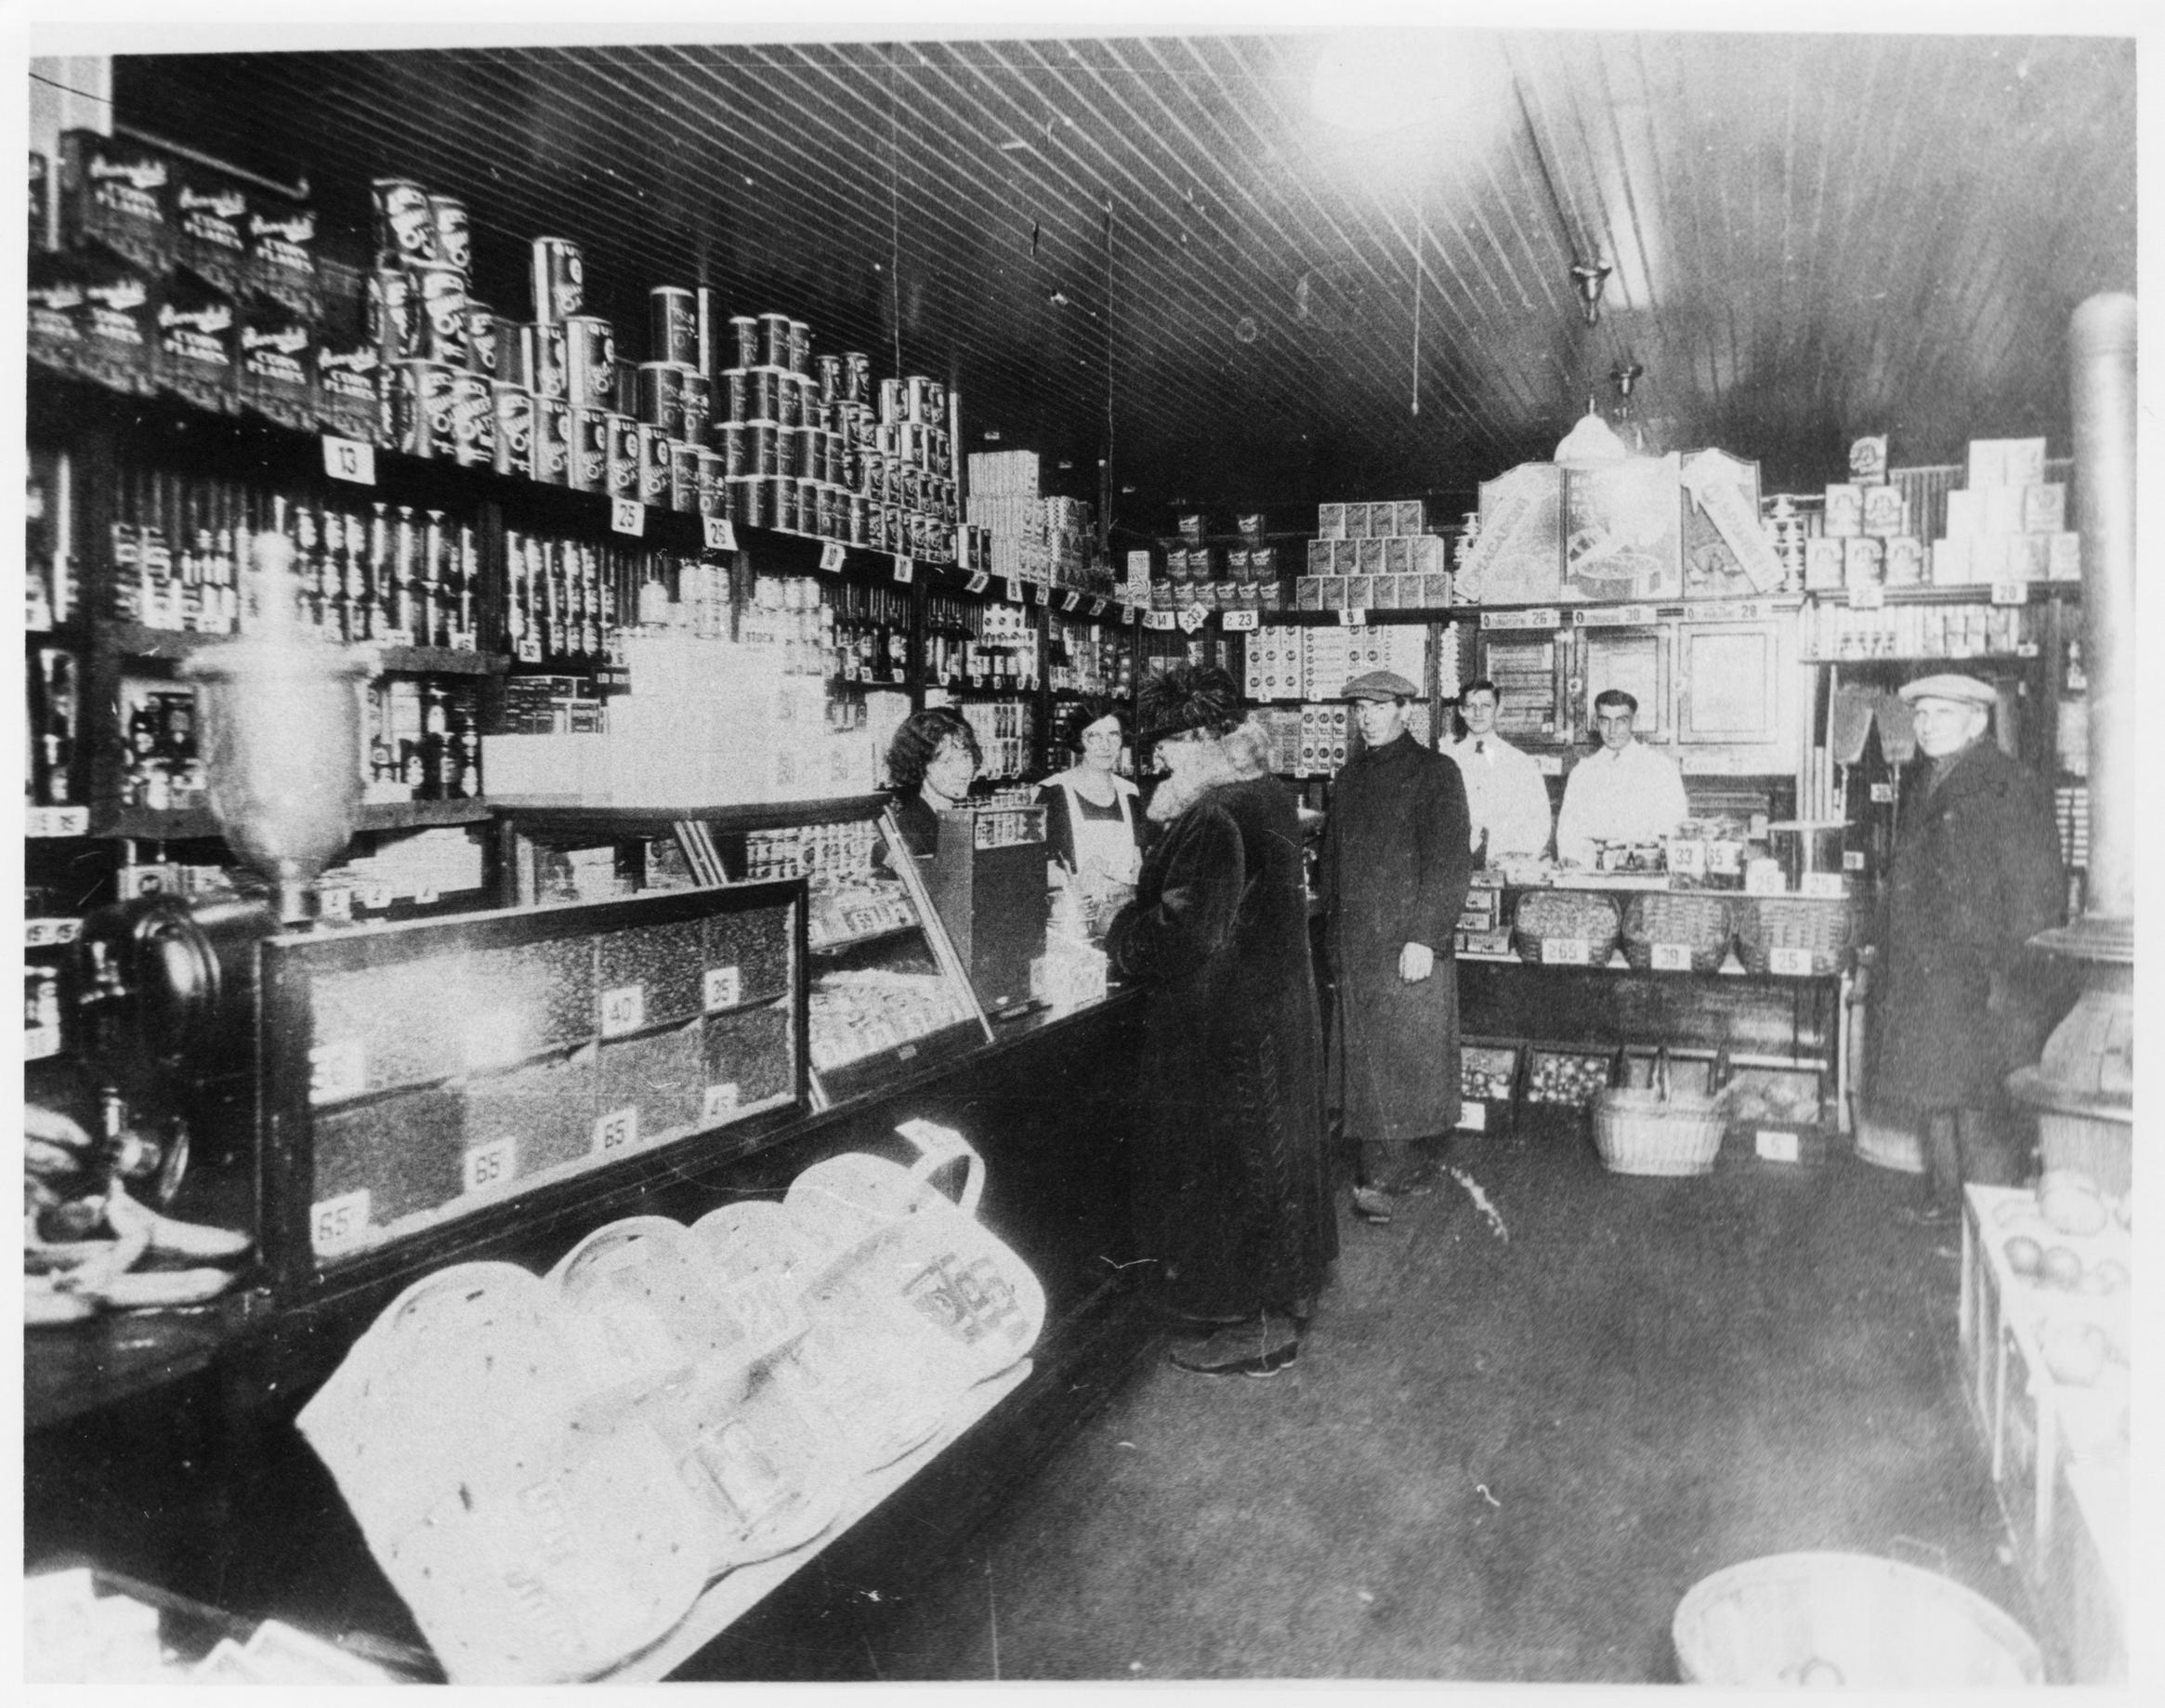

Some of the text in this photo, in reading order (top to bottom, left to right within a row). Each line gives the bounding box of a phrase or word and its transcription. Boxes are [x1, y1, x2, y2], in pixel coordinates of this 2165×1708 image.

[619, 504, 636, 528] 25
[1238, 613, 1253, 626] 23
[1531, 611, 1547, 625] 26
[1674, 847, 1694, 866] 33
[605, 1119, 625, 1149] 65
[475, 1151, 500, 1184] 65
[319, 1205, 351, 1242] 65
